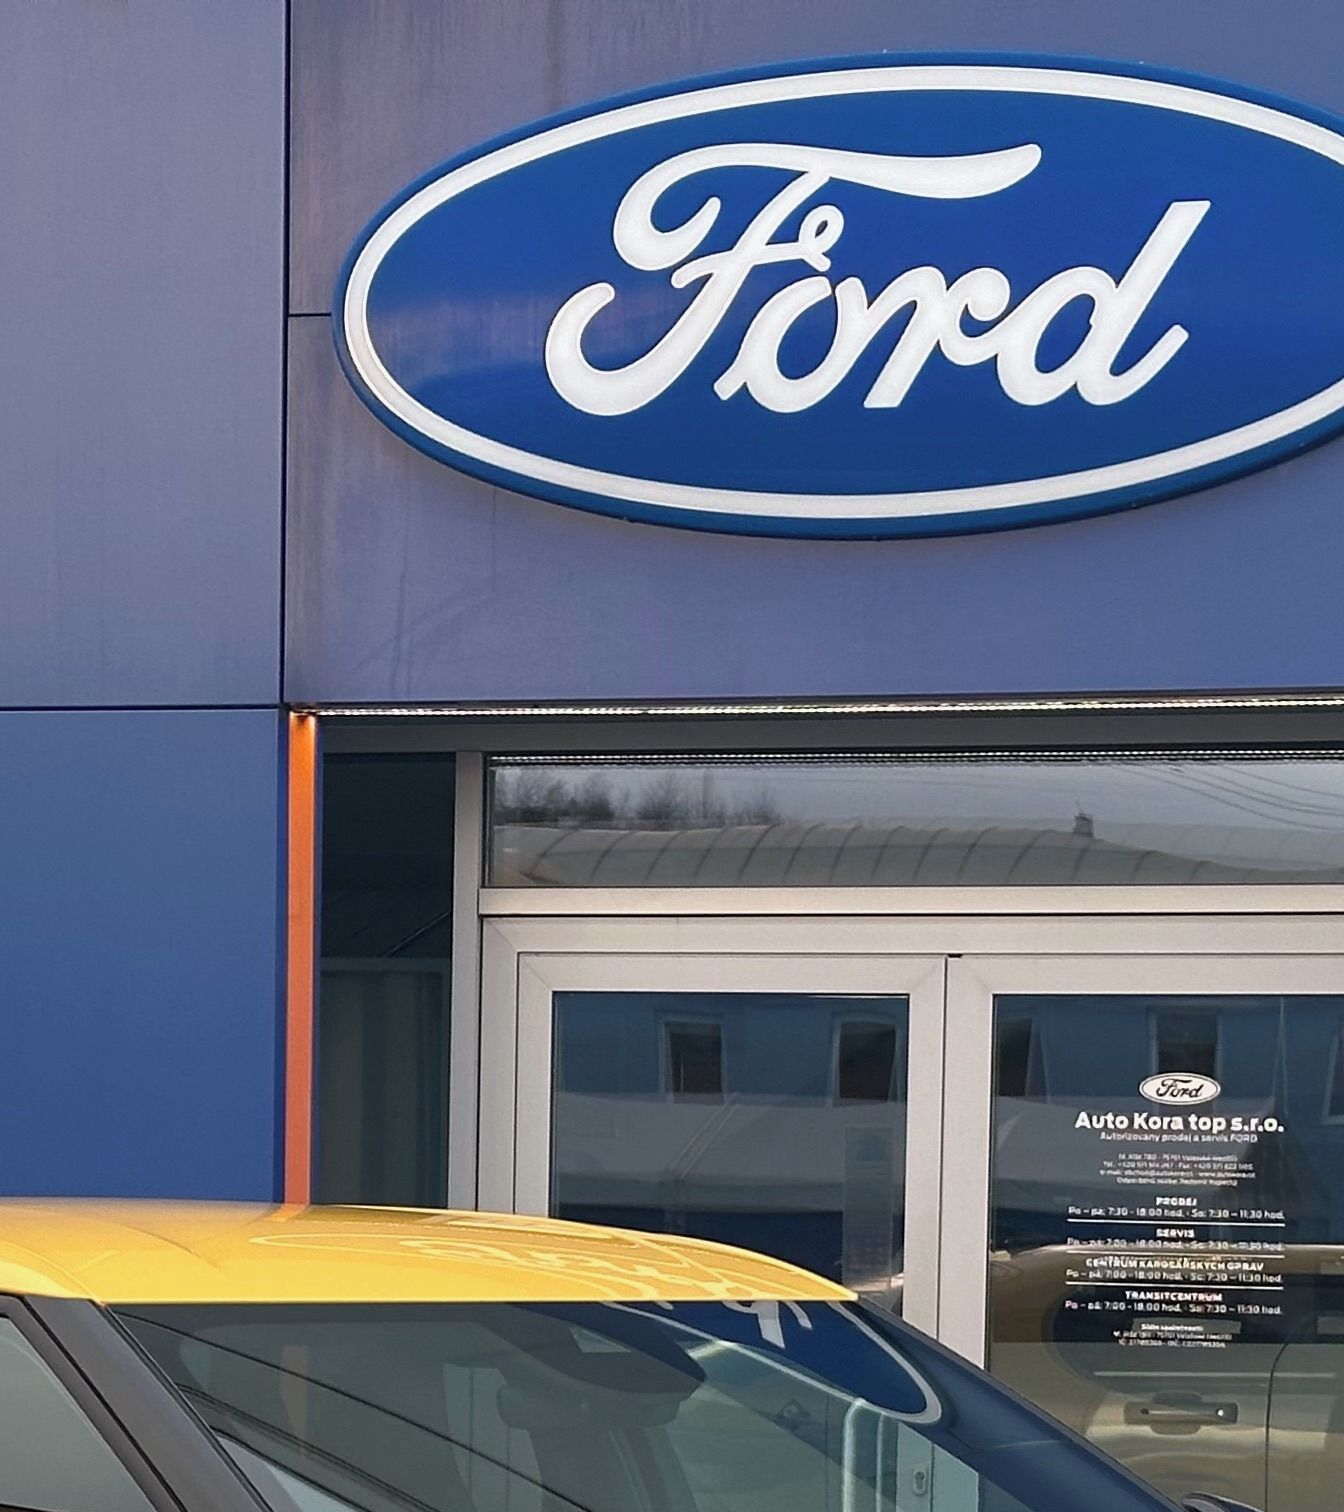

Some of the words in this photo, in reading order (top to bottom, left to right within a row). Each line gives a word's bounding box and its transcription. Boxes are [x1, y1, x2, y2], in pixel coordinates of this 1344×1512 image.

[546, 142, 1210, 416] Ford
[1156, 1079, 1204, 1098] Ford
[1075, 1111, 1128, 1129] Auto
[1134, 1112, 1184, 1130] Kora
[1188, 1114, 1226, 1134] top
[1231, 1117, 1284, 1132] s.r.o.
[1230, 1133, 1258, 1143] FORD
[1156, 1197, 1197, 1206] PRODEJ
[1156, 1228, 1195, 1238] SERVIS
[1086, 1257, 1137, 1268] CENTRUM
[1125, 1290, 1222, 1301] TRANSITCENTRUM
